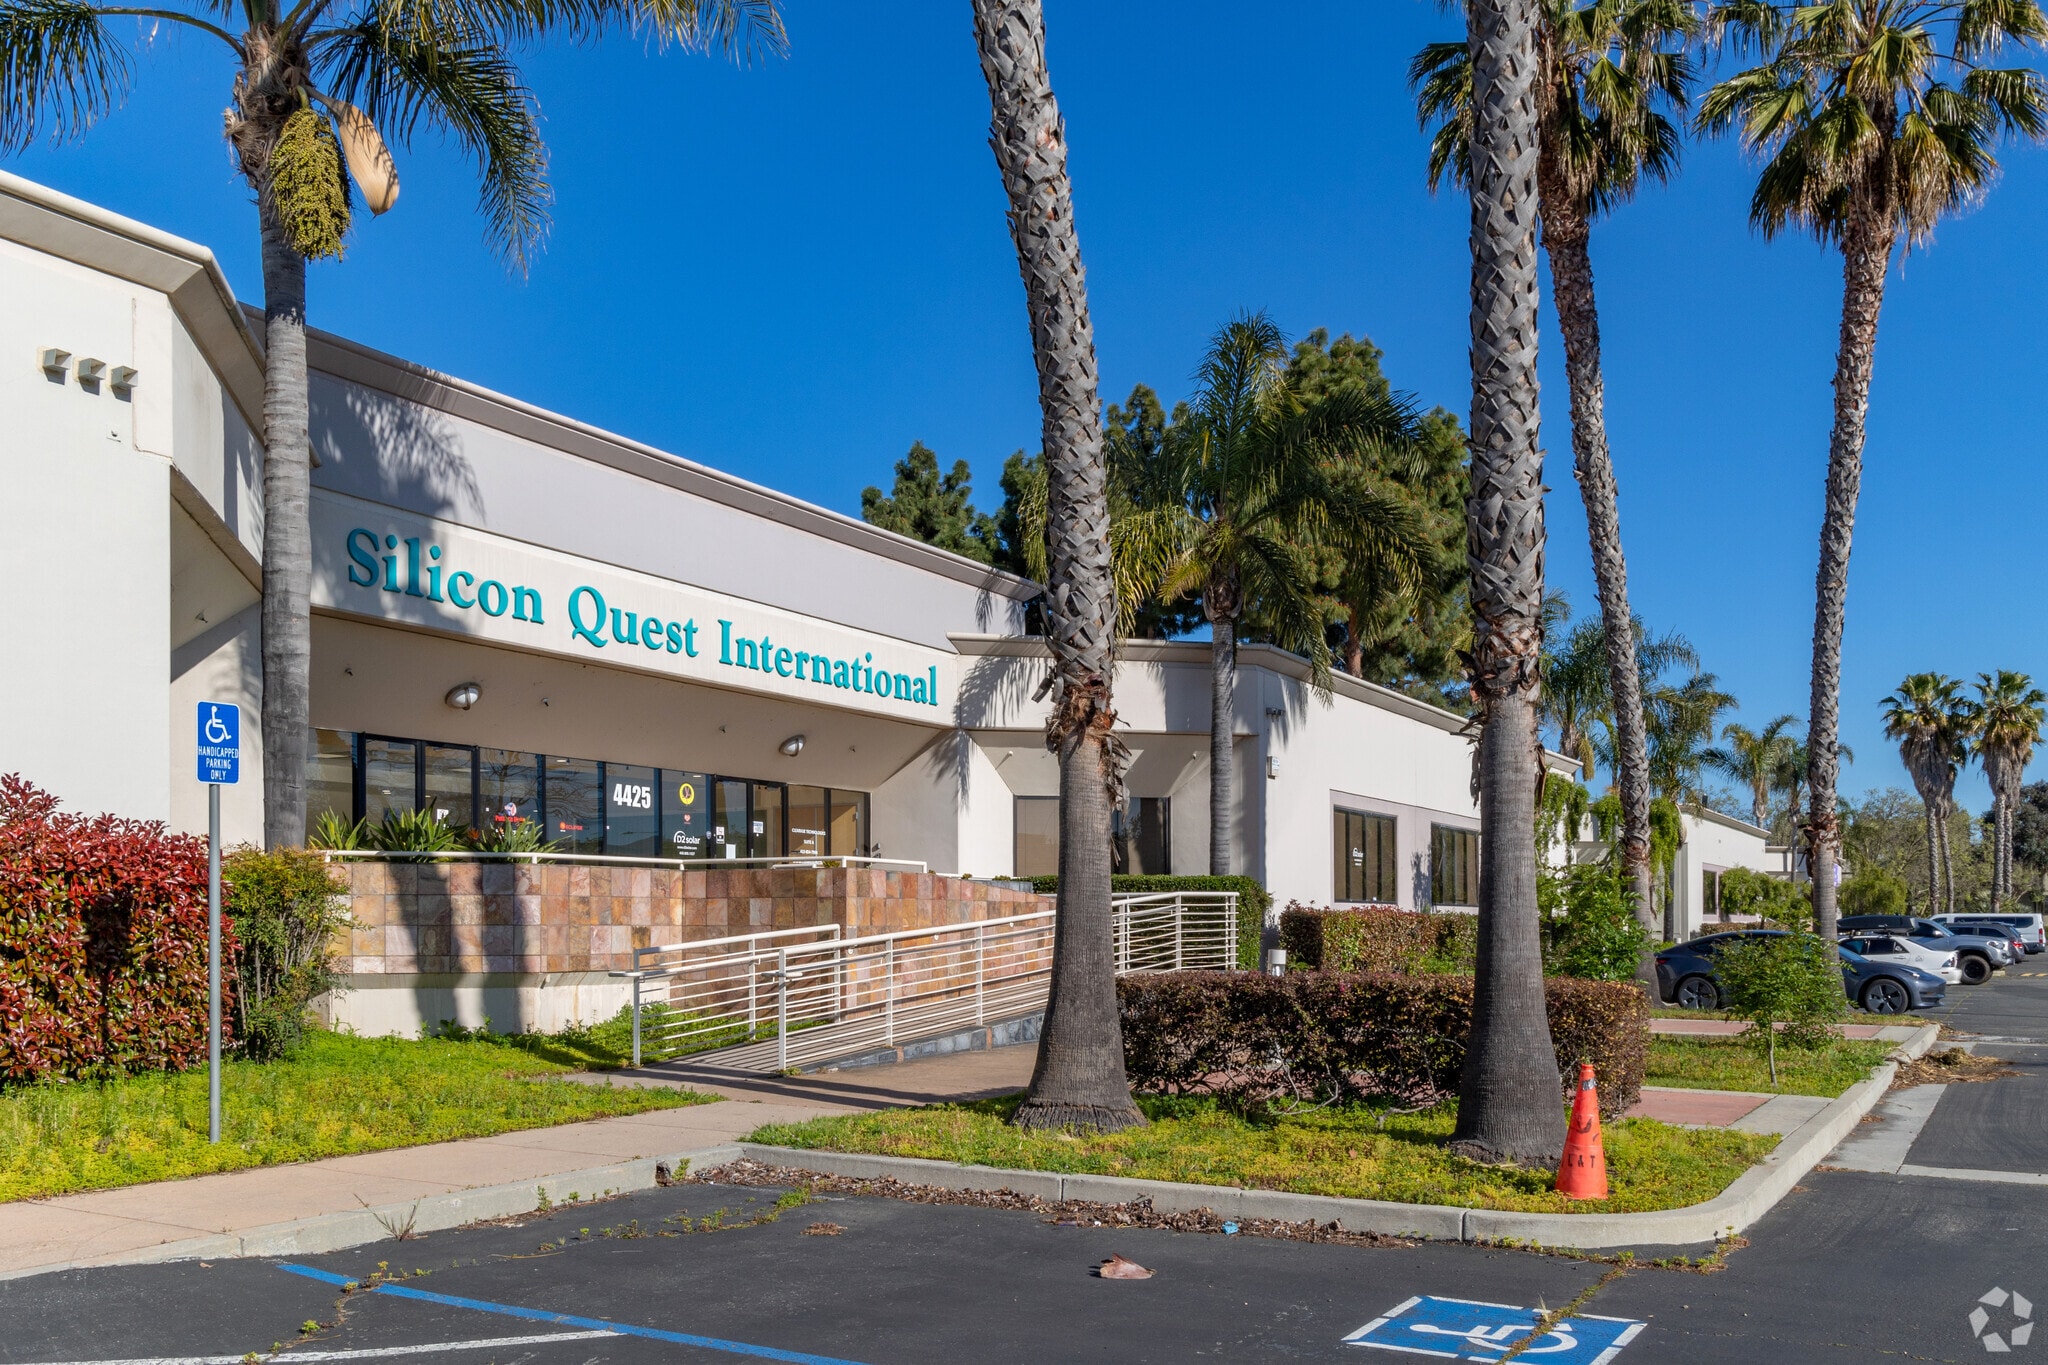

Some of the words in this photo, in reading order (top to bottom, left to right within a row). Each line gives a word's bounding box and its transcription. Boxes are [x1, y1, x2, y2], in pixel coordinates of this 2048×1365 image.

[347, 527, 544, 625] Silicon
[567, 584, 698, 657] Quest
[717, 618, 938, 707] International
[198, 745, 239, 759] HANDICAPPED
[205, 757, 232, 770] PARKING
[210, 769, 227, 781] ONLY
[613, 783, 652, 809] 4425
